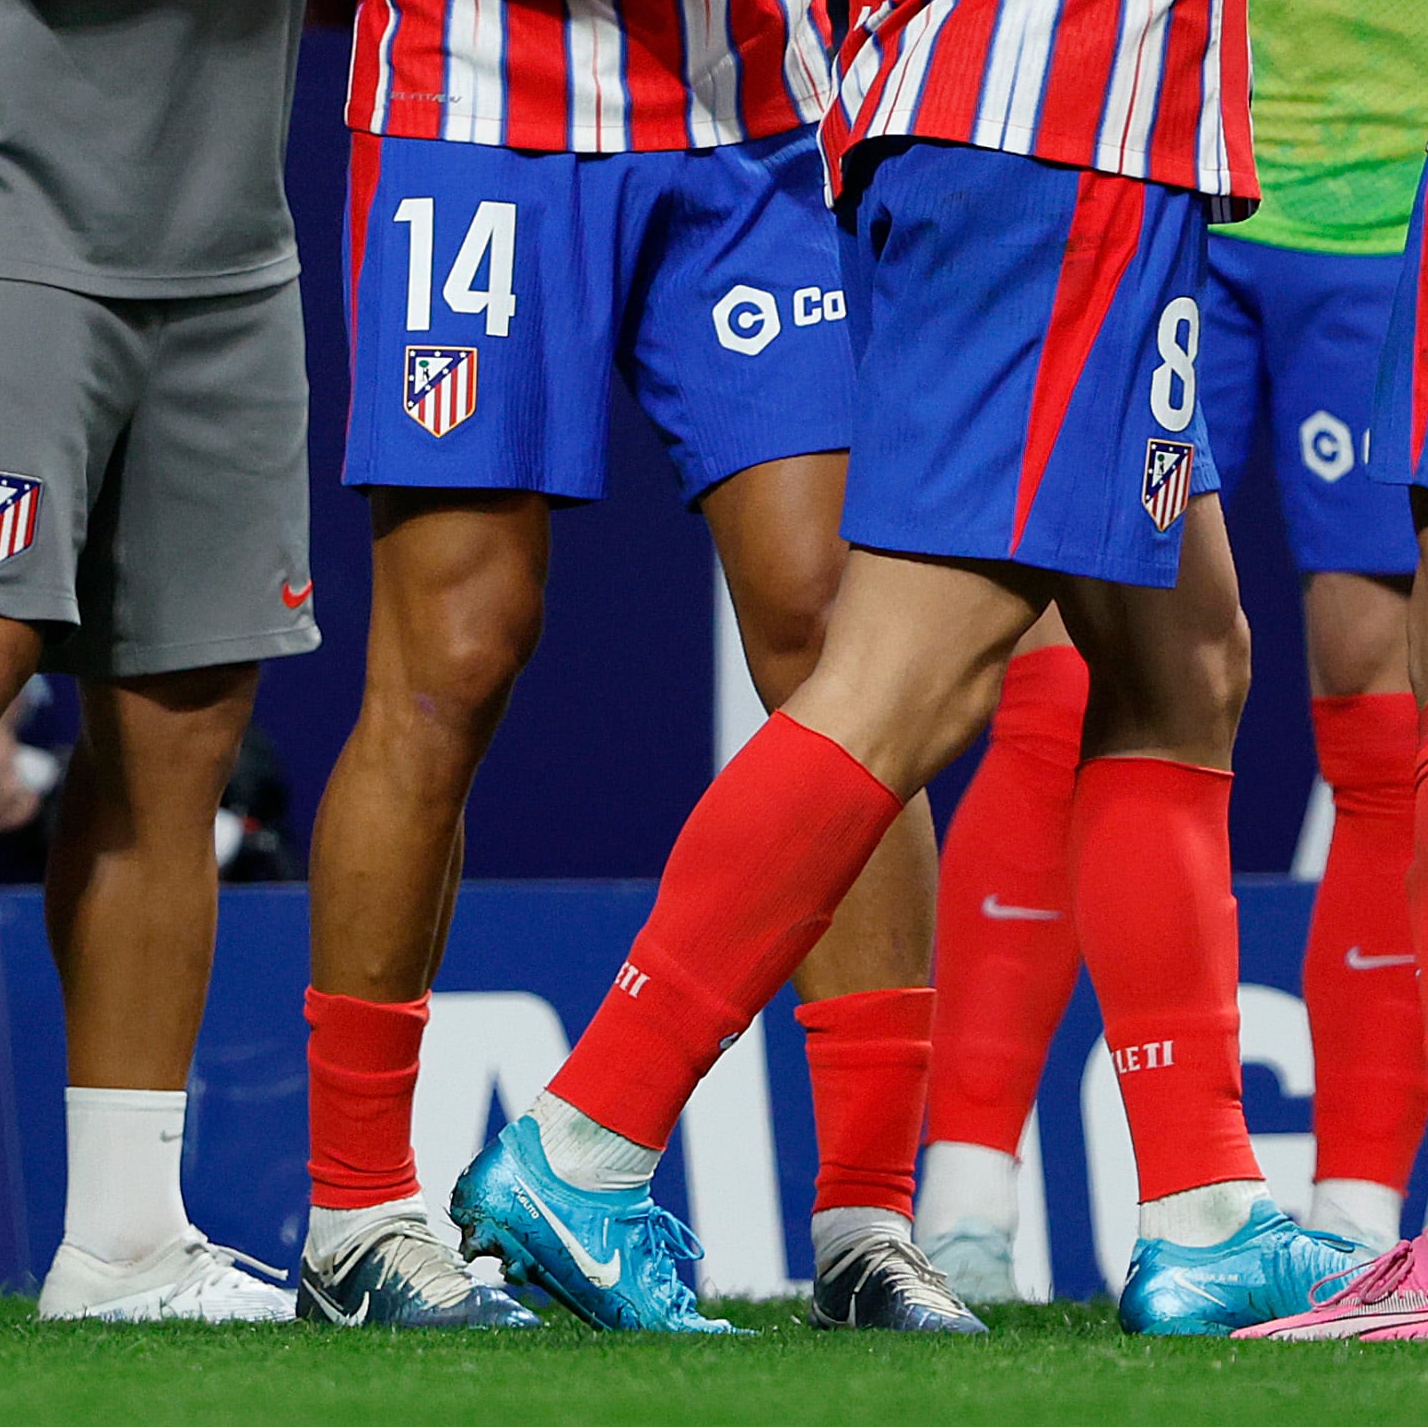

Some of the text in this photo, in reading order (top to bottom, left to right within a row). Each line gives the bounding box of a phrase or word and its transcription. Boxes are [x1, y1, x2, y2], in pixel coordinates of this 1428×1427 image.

[393, 197, 517, 337] 14
[793, 286, 847, 327] Co
[1150, 296, 1200, 433] 8
